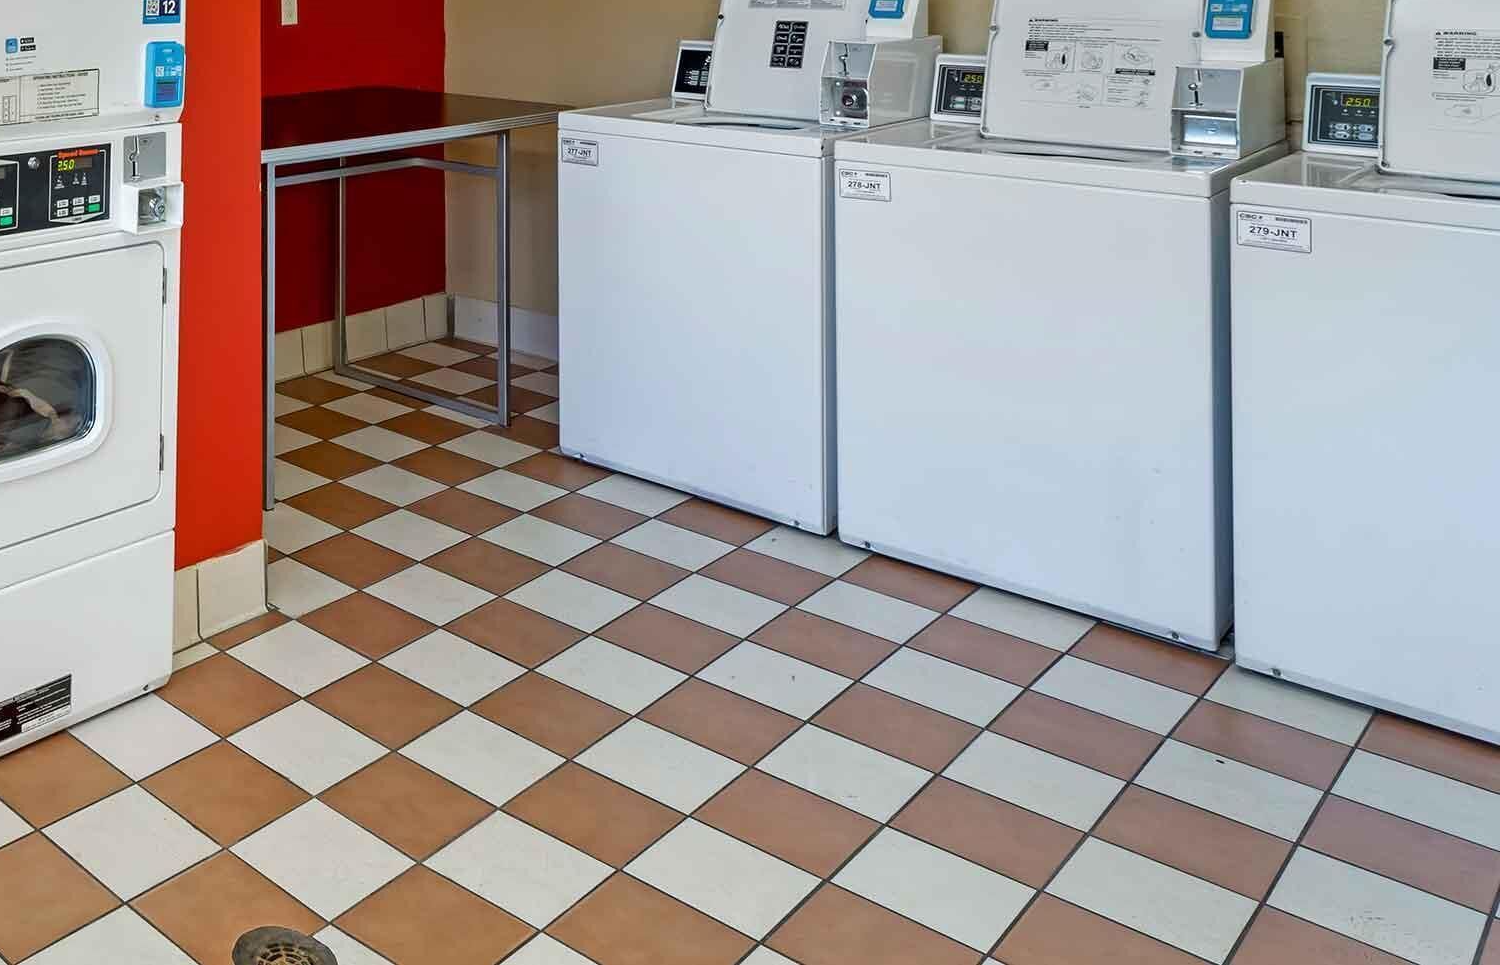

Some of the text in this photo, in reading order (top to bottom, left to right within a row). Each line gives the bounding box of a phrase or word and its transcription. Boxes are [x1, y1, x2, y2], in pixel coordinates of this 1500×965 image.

[162, 0, 176, 14] 12
[847, 180, 881, 189] 278-JNT
[1249, 226, 1297, 238] 279-JNT
